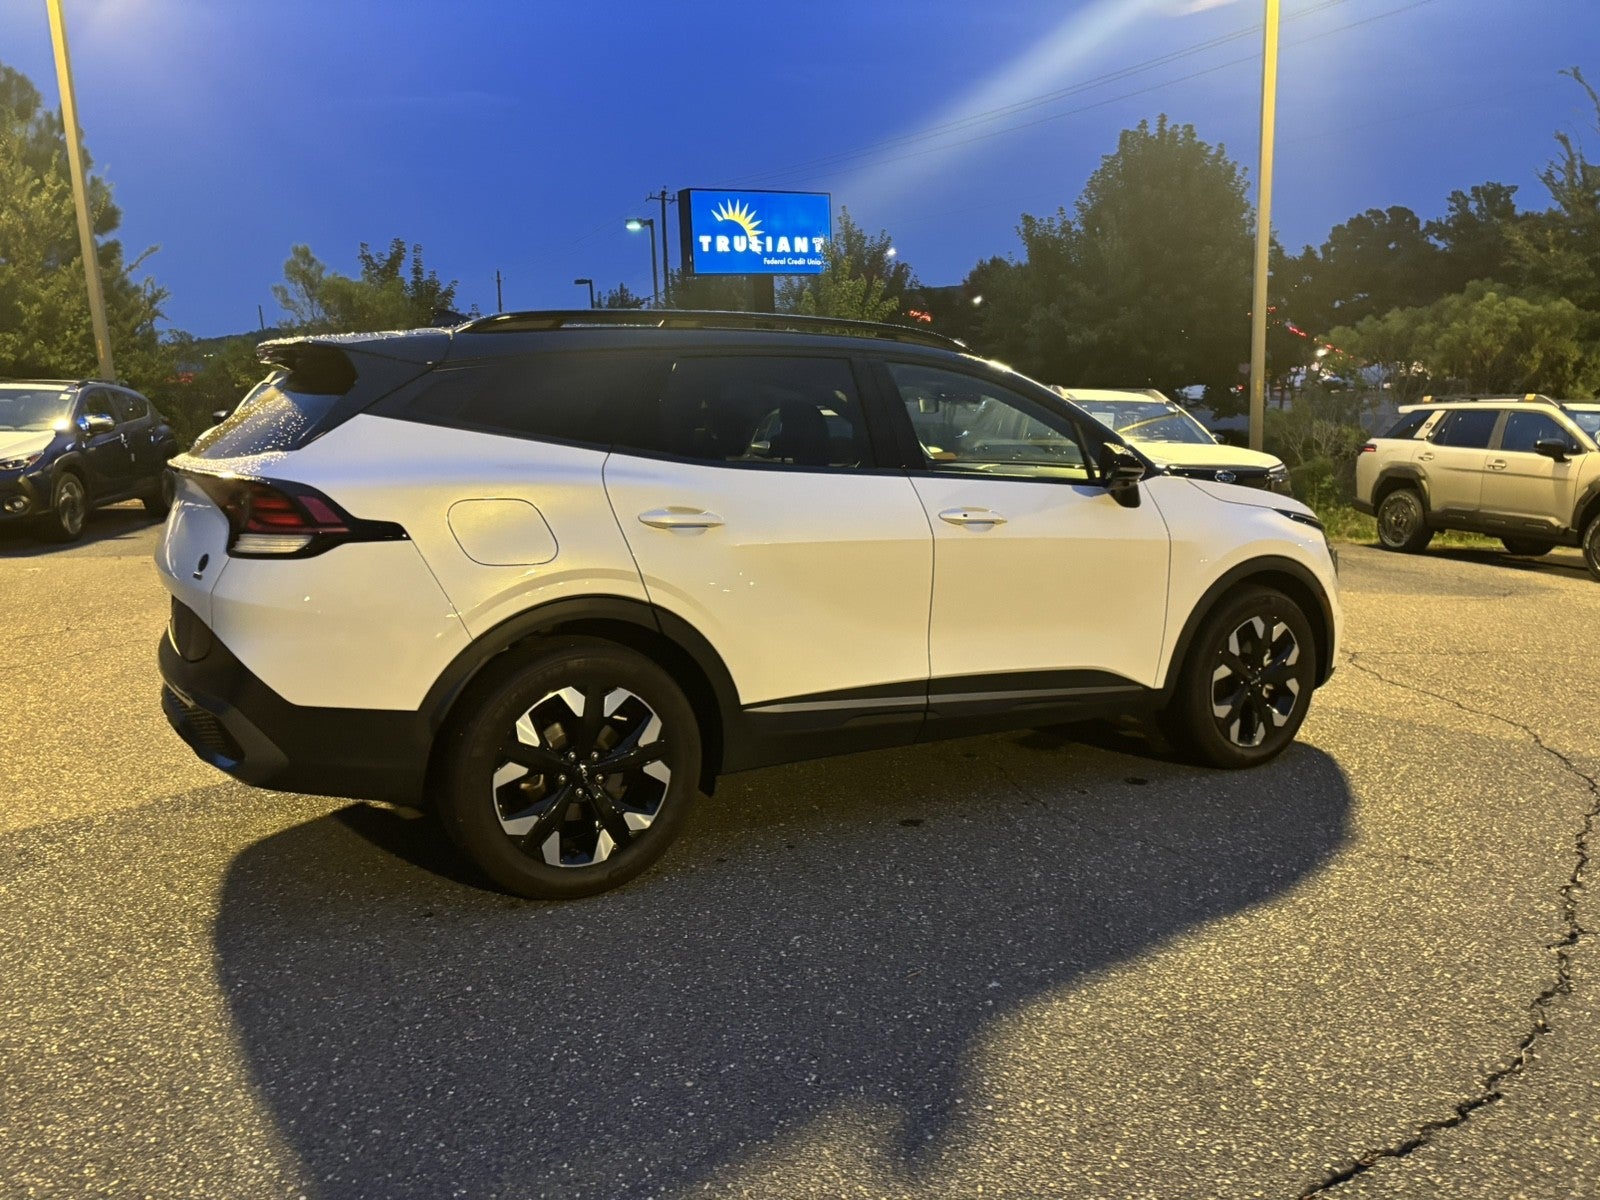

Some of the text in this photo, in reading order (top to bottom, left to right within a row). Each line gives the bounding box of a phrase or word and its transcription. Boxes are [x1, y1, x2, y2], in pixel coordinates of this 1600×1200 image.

[763, 257, 824, 266] Federal Credit Unio
